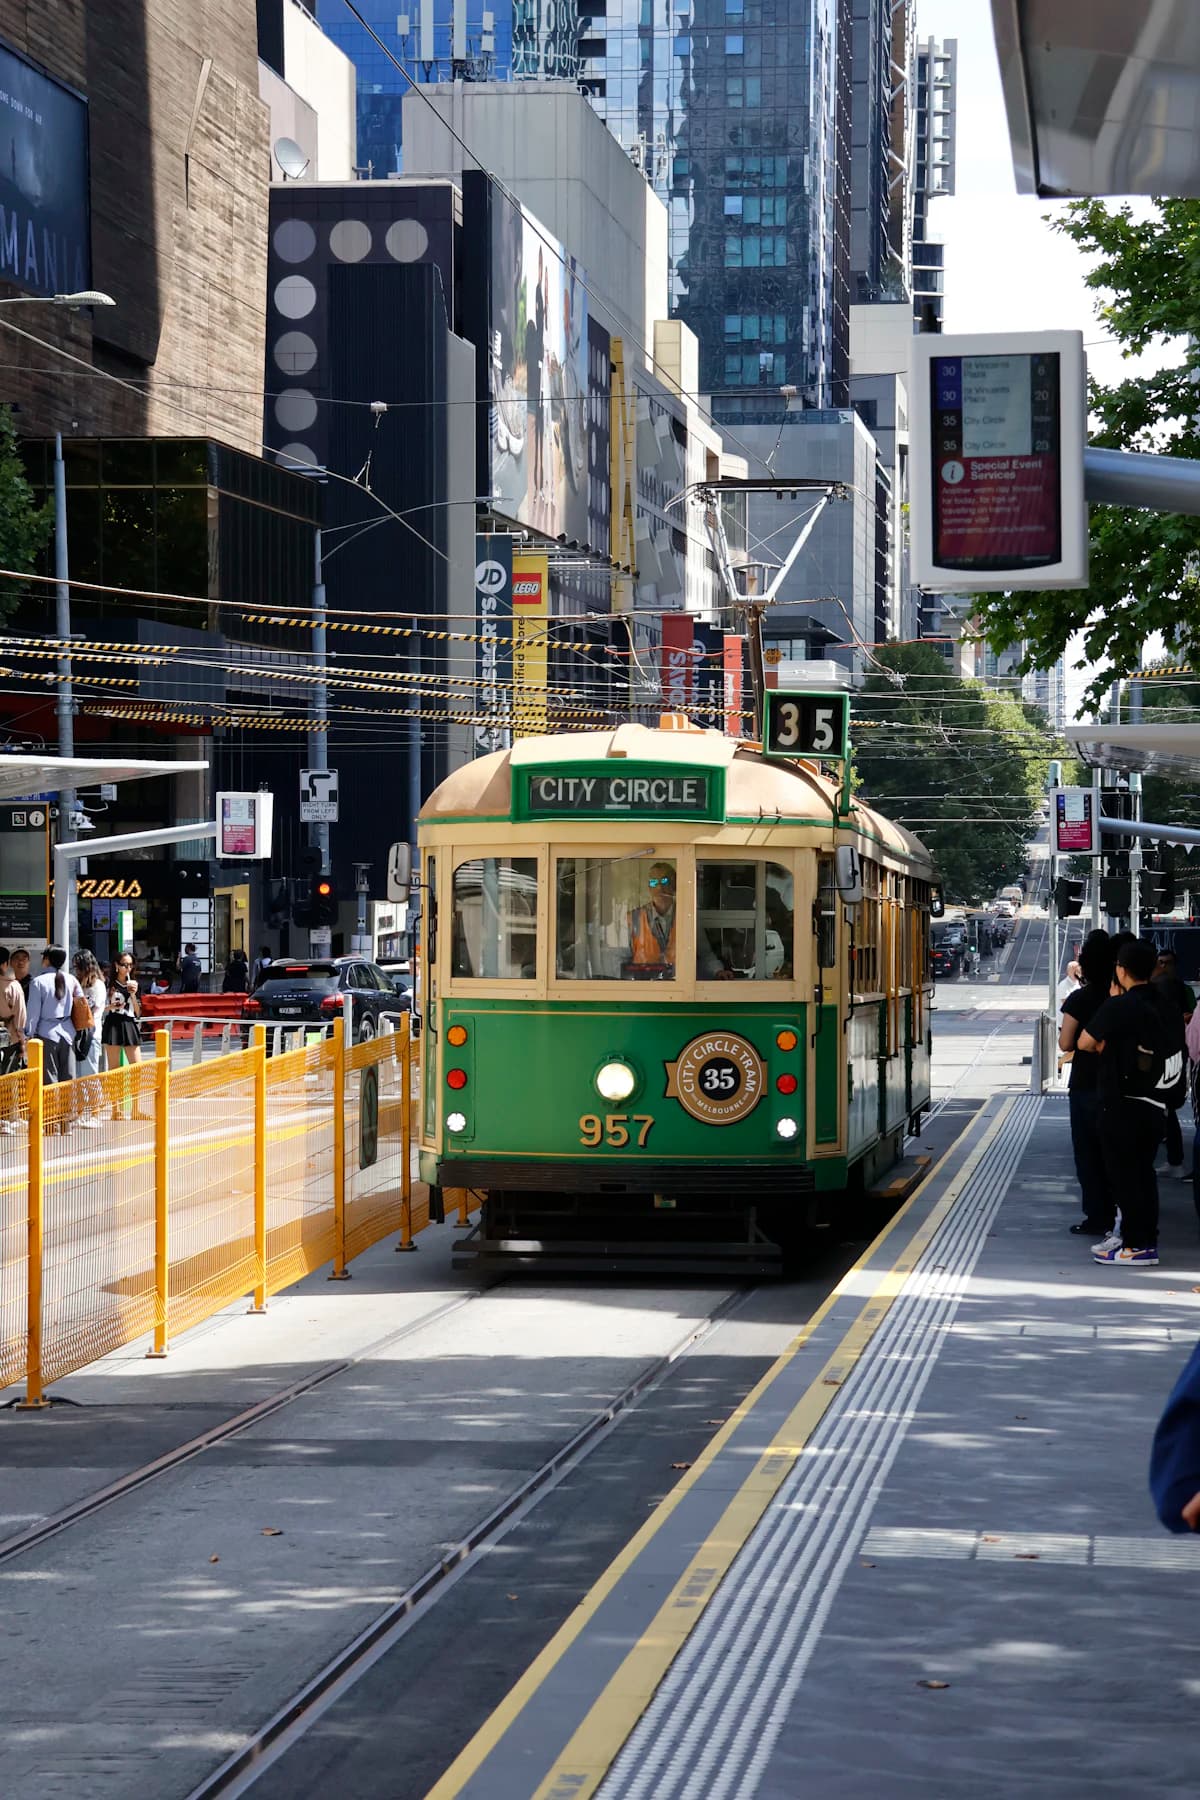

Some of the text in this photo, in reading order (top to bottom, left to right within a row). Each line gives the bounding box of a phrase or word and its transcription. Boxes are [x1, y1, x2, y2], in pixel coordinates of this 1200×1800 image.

[942, 365, 956, 377] 30
[943, 390, 956, 401] 30
[1035, 390, 1049, 401] 20
[943, 415, 957, 426] 35
[943, 439, 957, 451] 35
[970, 459, 1043, 471] Special Event
[970, 470, 1016, 480] Services
[478, 568, 502, 586] JD
[513, 583, 539, 594] LEGO
[539, 777, 697, 803] CITY CIRCLE
[682, 1040, 757, 1093] CITY CIRCLE TRAM
[703, 1067, 735, 1091] 35
[696, 1099, 745, 1114] MELBOURNE
[578, 1114, 655, 1147] 957
